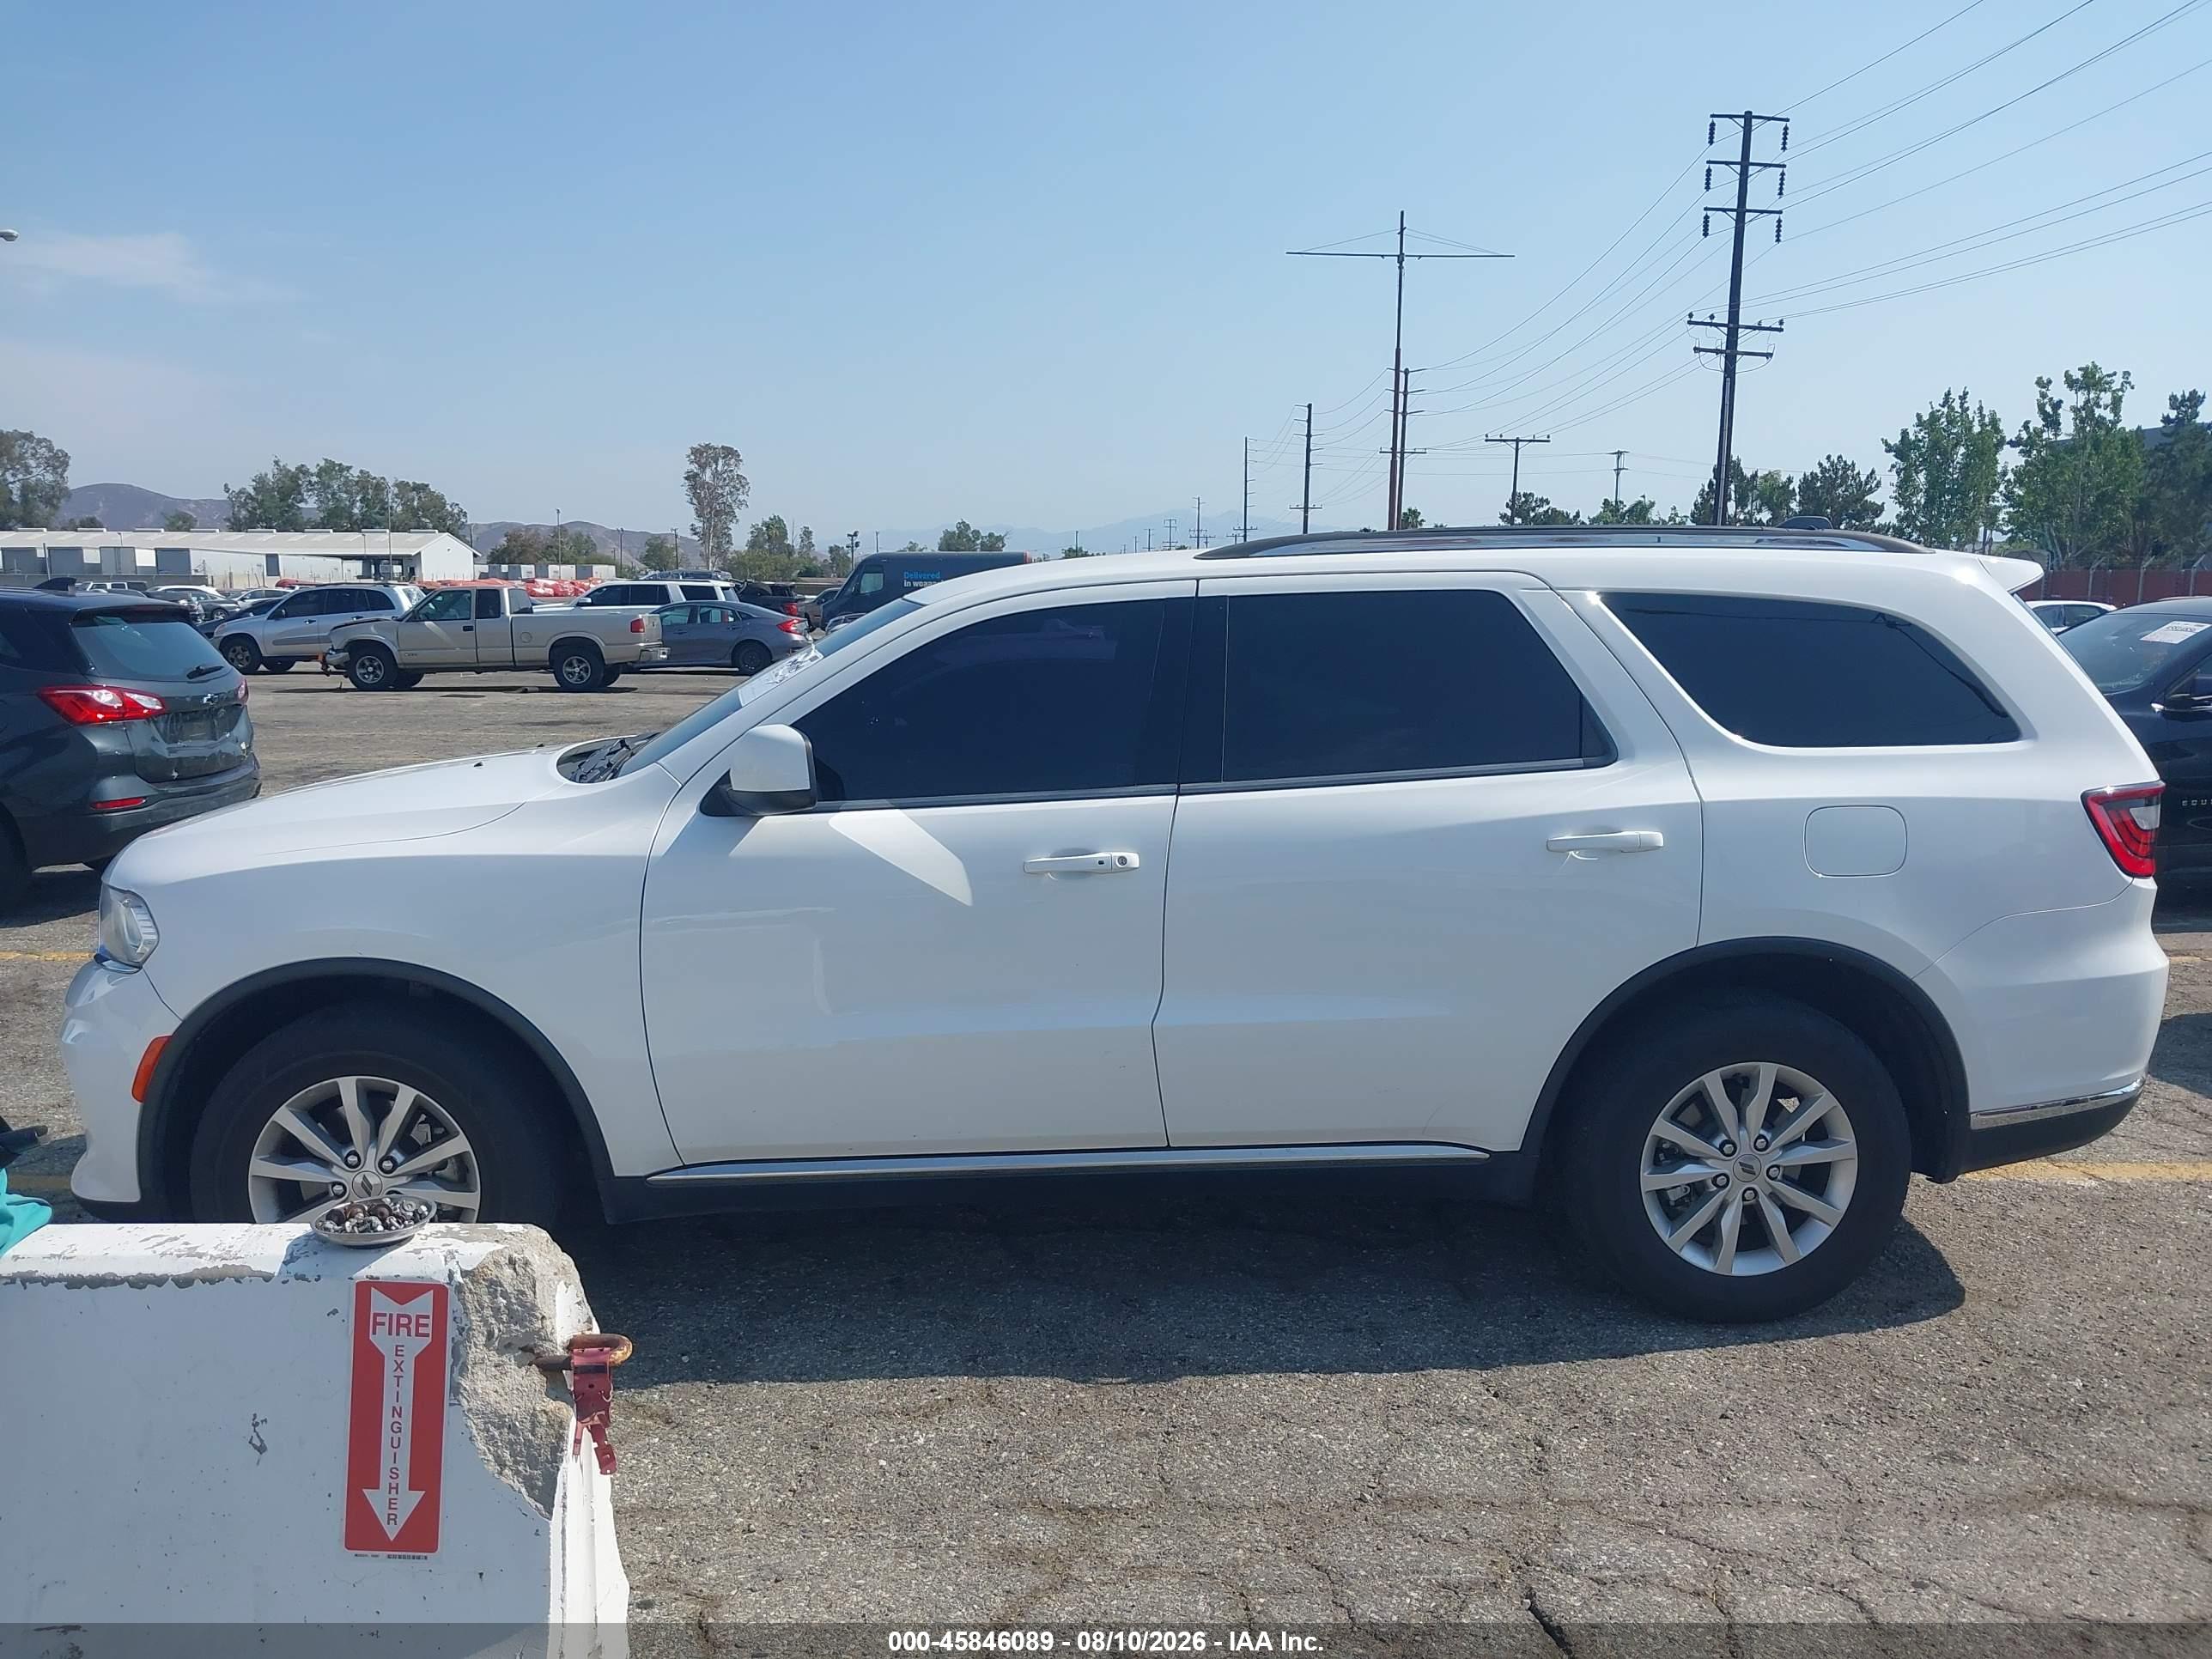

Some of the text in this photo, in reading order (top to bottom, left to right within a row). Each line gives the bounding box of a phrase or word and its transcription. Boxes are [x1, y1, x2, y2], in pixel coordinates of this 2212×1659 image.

[903, 571, 941, 580] Delivered
[371, 1313, 431, 1338] FIRE
[386, 1344, 405, 1527] EXTINGUISHER
